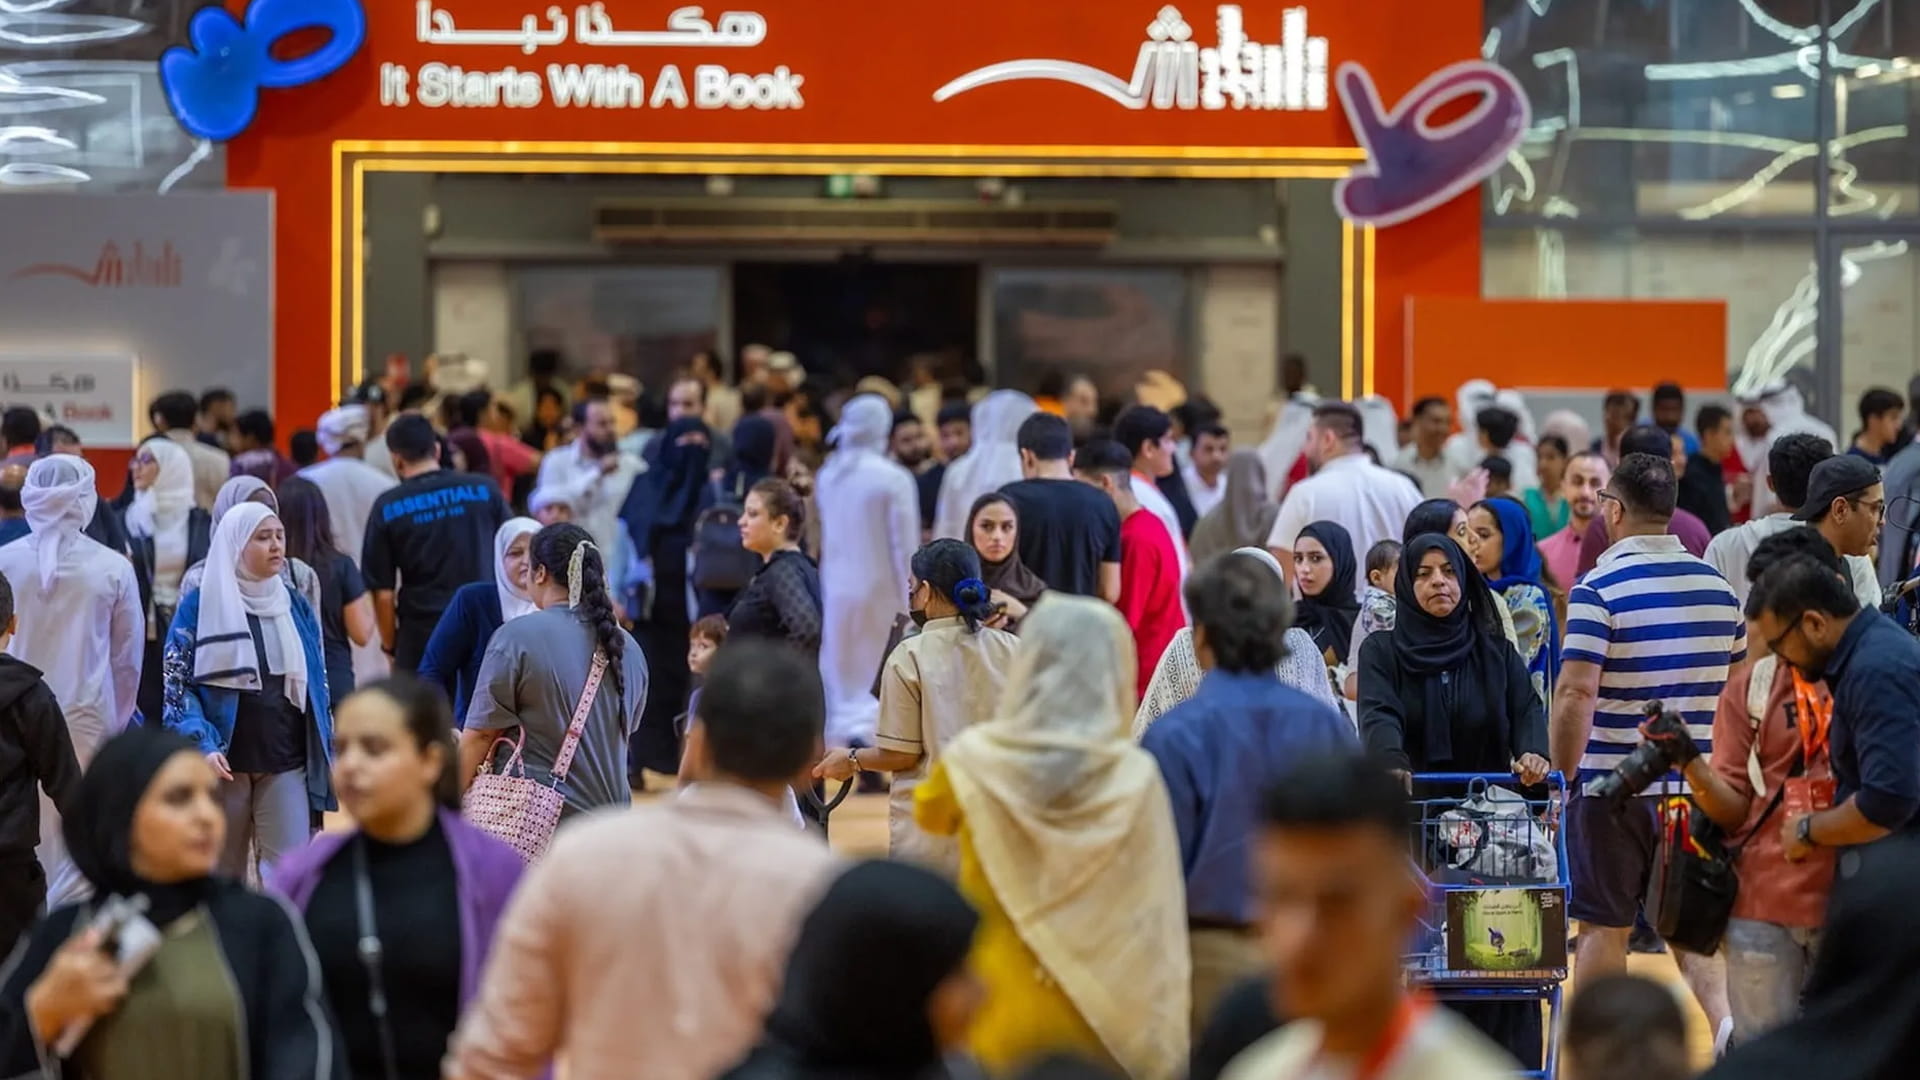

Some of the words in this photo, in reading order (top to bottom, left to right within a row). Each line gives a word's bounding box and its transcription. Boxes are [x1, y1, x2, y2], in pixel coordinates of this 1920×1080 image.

[575, 1, 767, 47] هكذا
[380, 62, 410, 107] It
[416, 62, 543, 108] Starts
[546, 63, 645, 108] With
[649, 64, 689, 108] A
[694, 64, 805, 110] Book
[382, 484, 491, 522] ESSENTIALS
